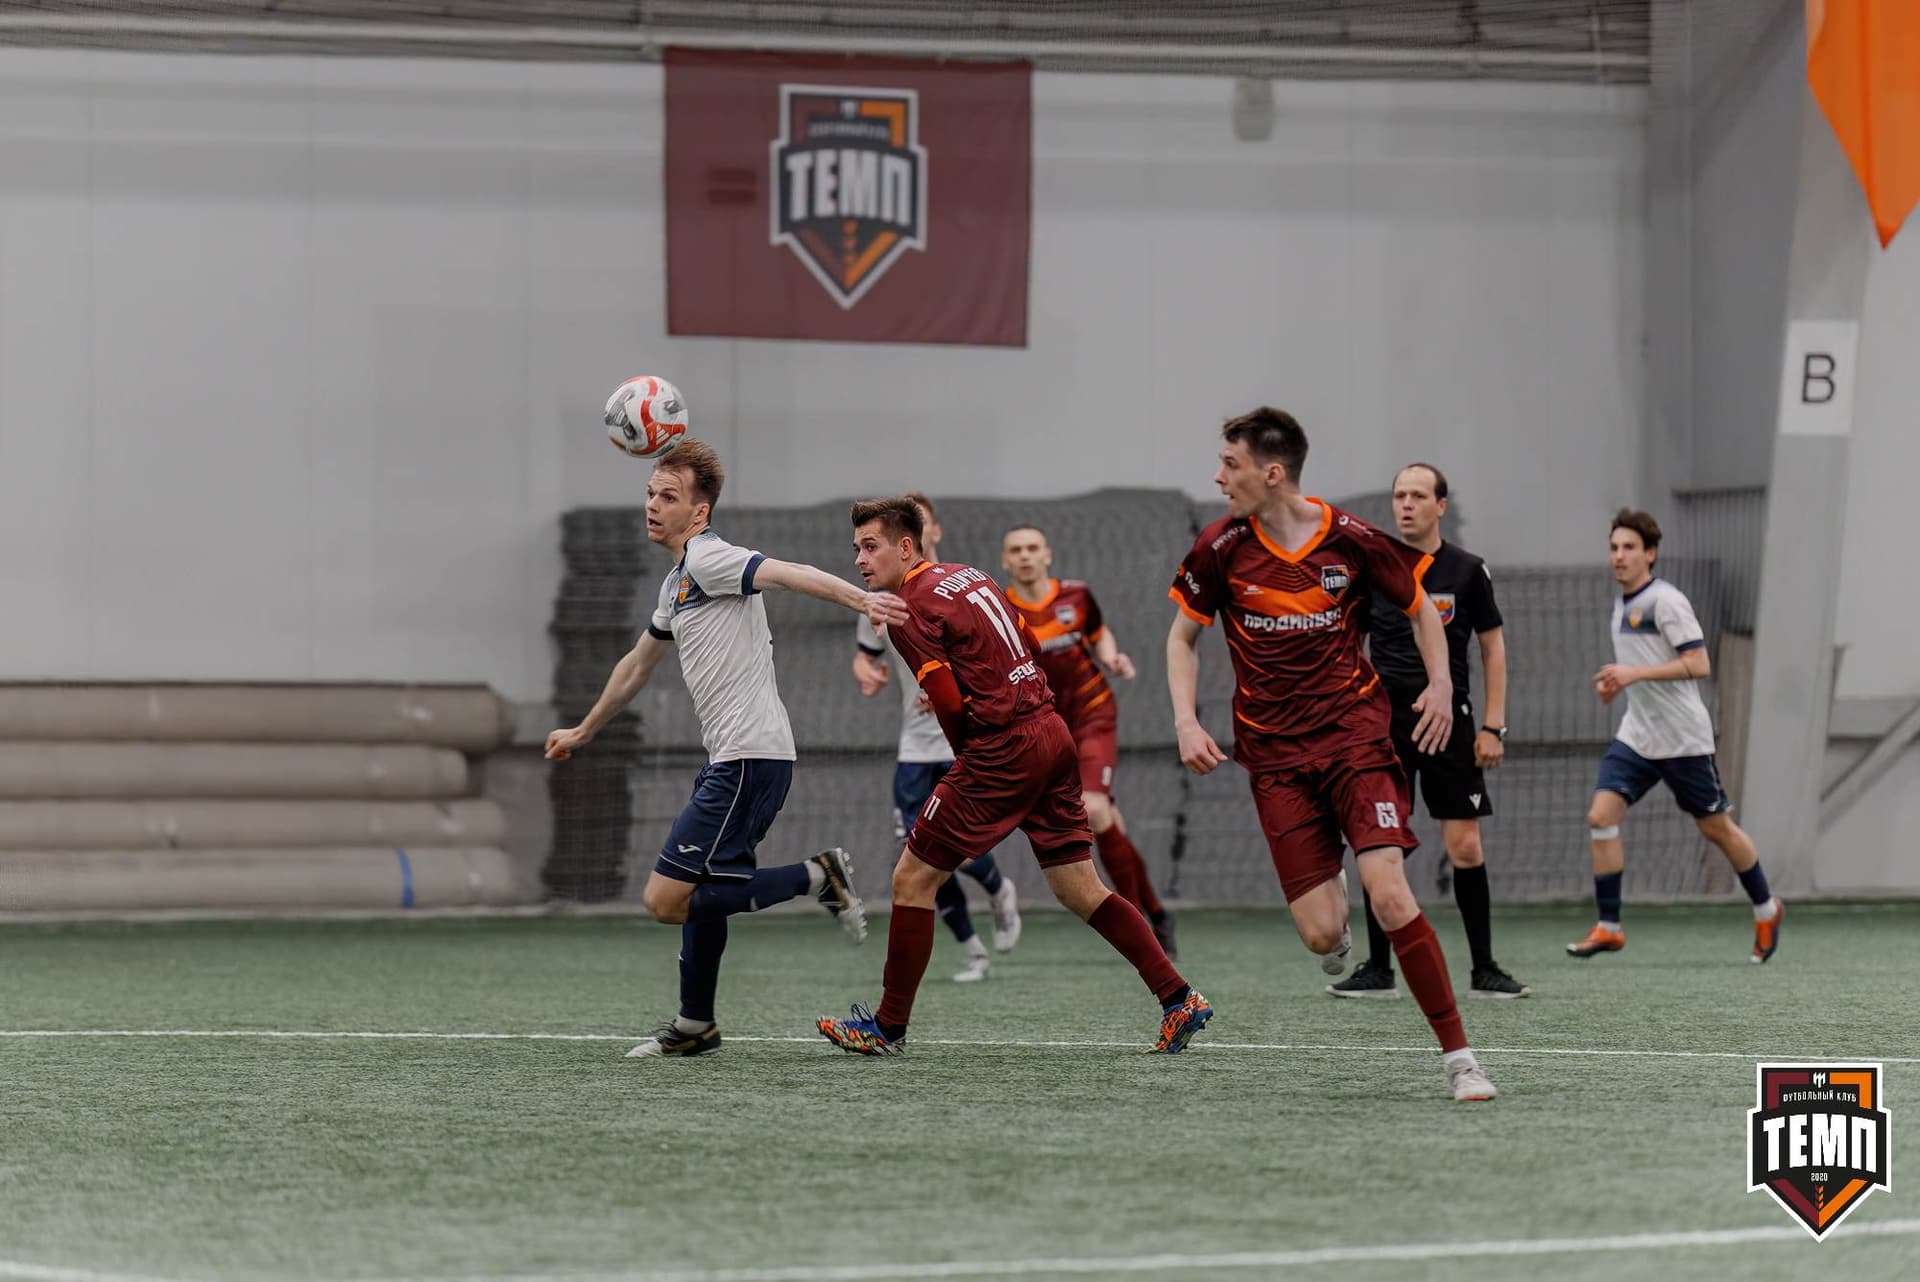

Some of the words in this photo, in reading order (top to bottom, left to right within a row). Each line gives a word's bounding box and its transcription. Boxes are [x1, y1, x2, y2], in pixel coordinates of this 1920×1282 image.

[786, 148, 912, 226] ТЕМП
[965, 586, 1026, 660] 11
[924, 795, 941, 820] 11
[1375, 802, 1400, 828] 63
